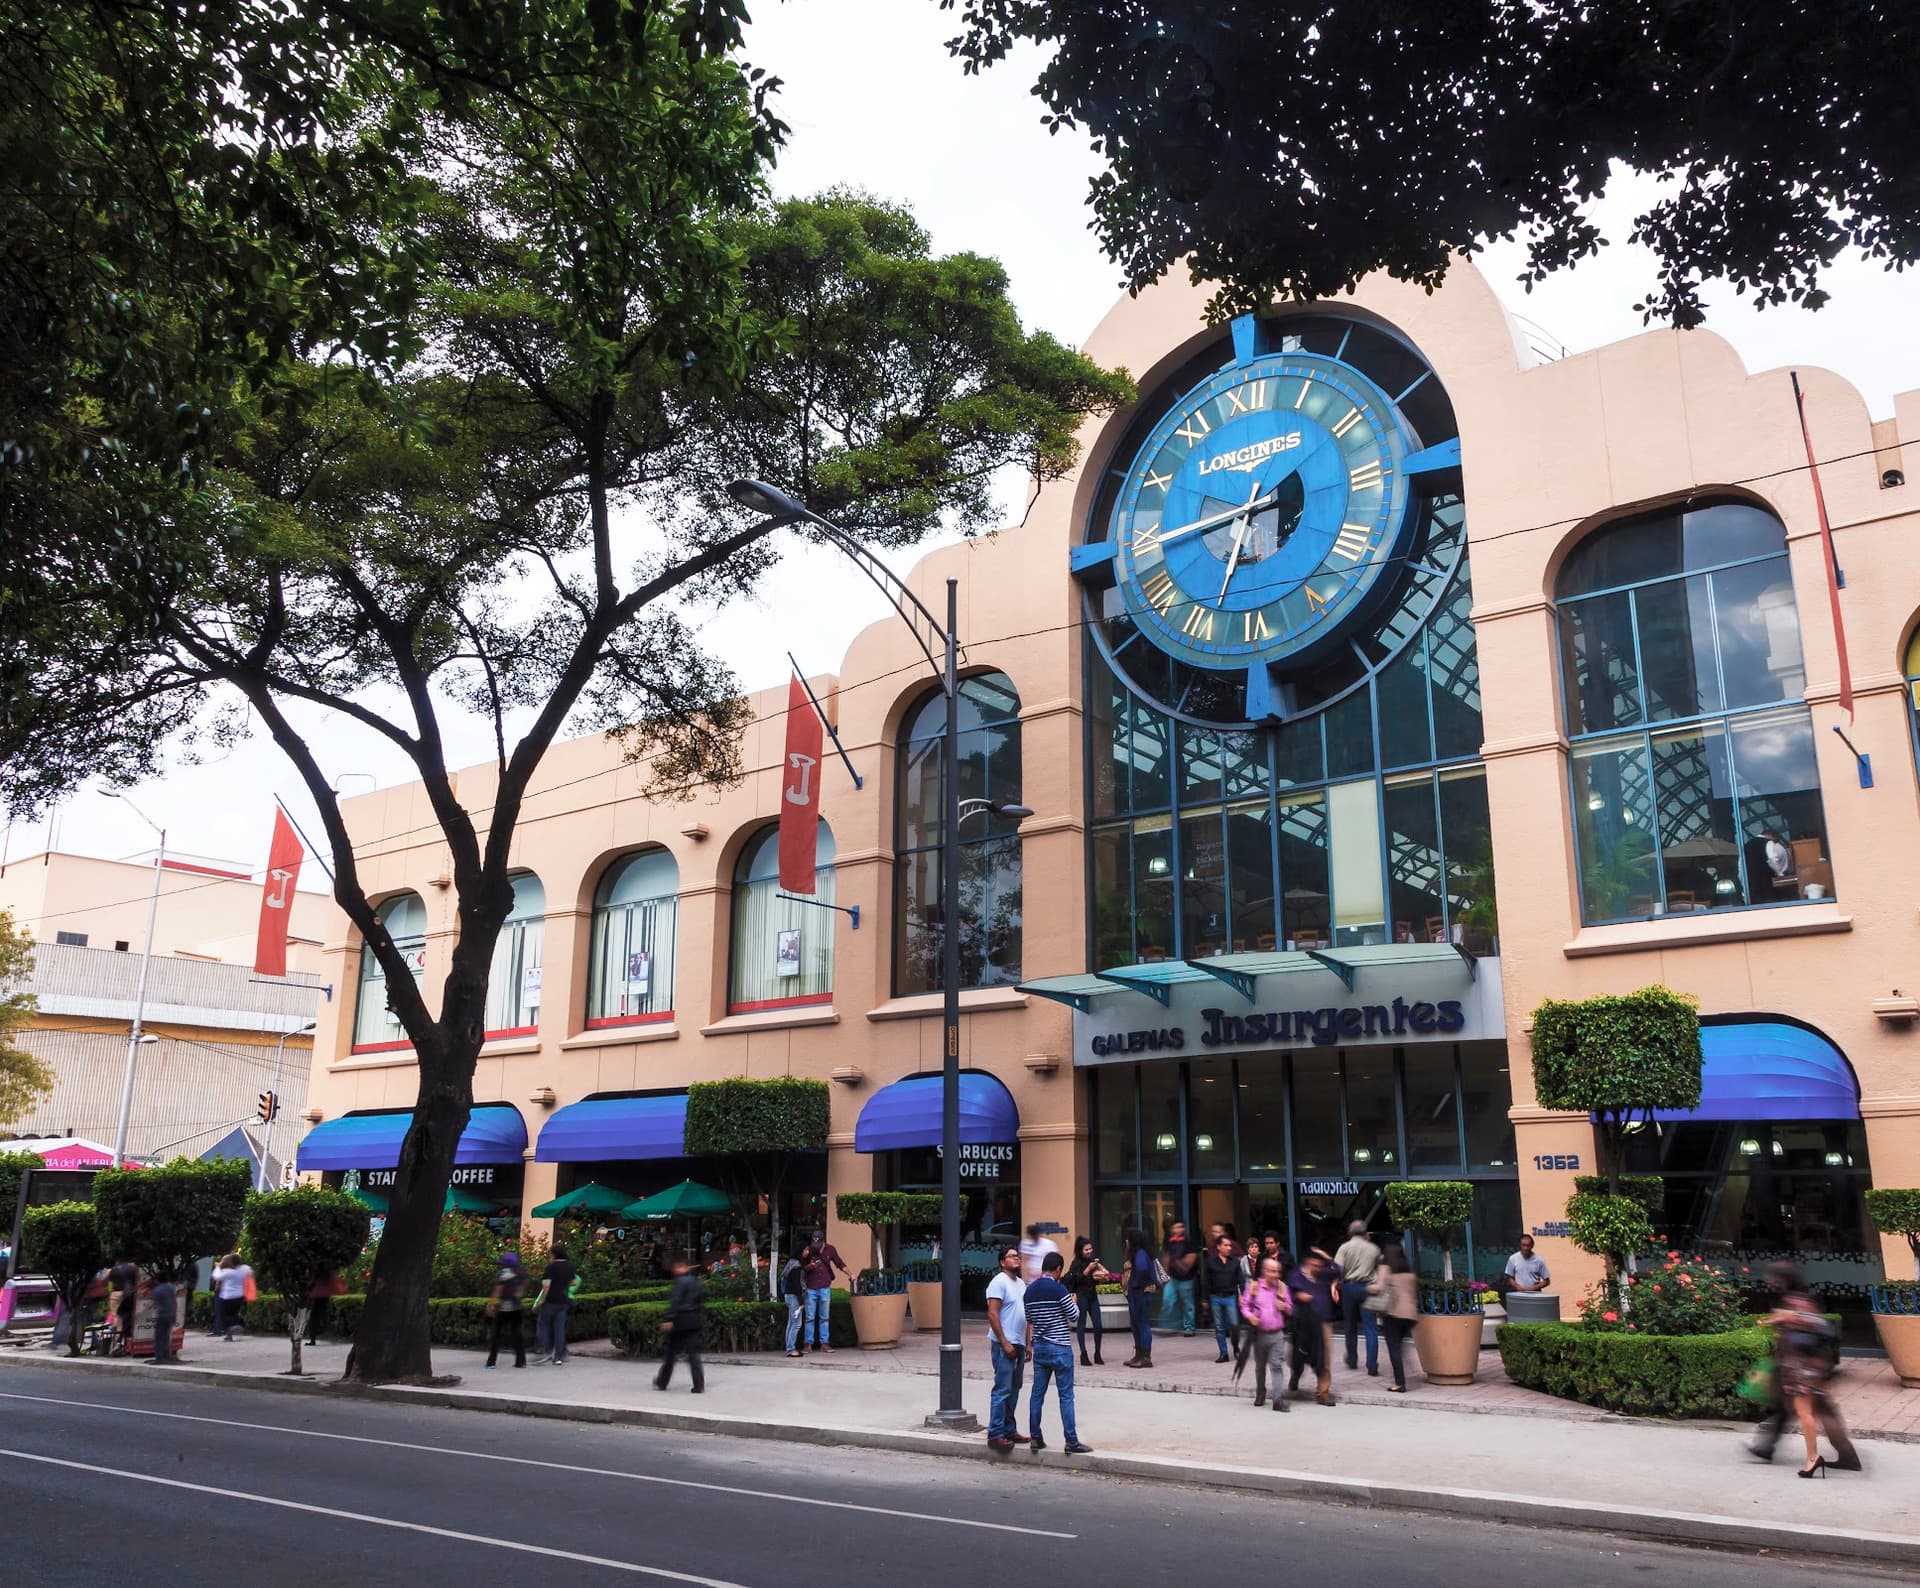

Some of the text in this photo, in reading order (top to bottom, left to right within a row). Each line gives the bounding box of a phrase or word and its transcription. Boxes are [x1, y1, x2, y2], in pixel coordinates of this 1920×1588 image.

[1226, 379, 1266, 417] XII
[1175, 409, 1211, 449] XI
[1331, 407, 1363, 439] II
[1199, 431, 1302, 476] LONGINES
[1143, 468, 1174, 492] X
[1350, 459, 1382, 492] III
[1182, 605, 1213, 641] VII
[1244, 610, 1270, 642] VI
[1091, 1027, 1185, 1057] GALERIAS
[936, 1144, 1013, 1160] SRBUCKS
[1533, 1155, 1579, 1170] 1352
[449, 1168, 495, 1185] OFFEE
[959, 1162, 999, 1176] OFFEE
